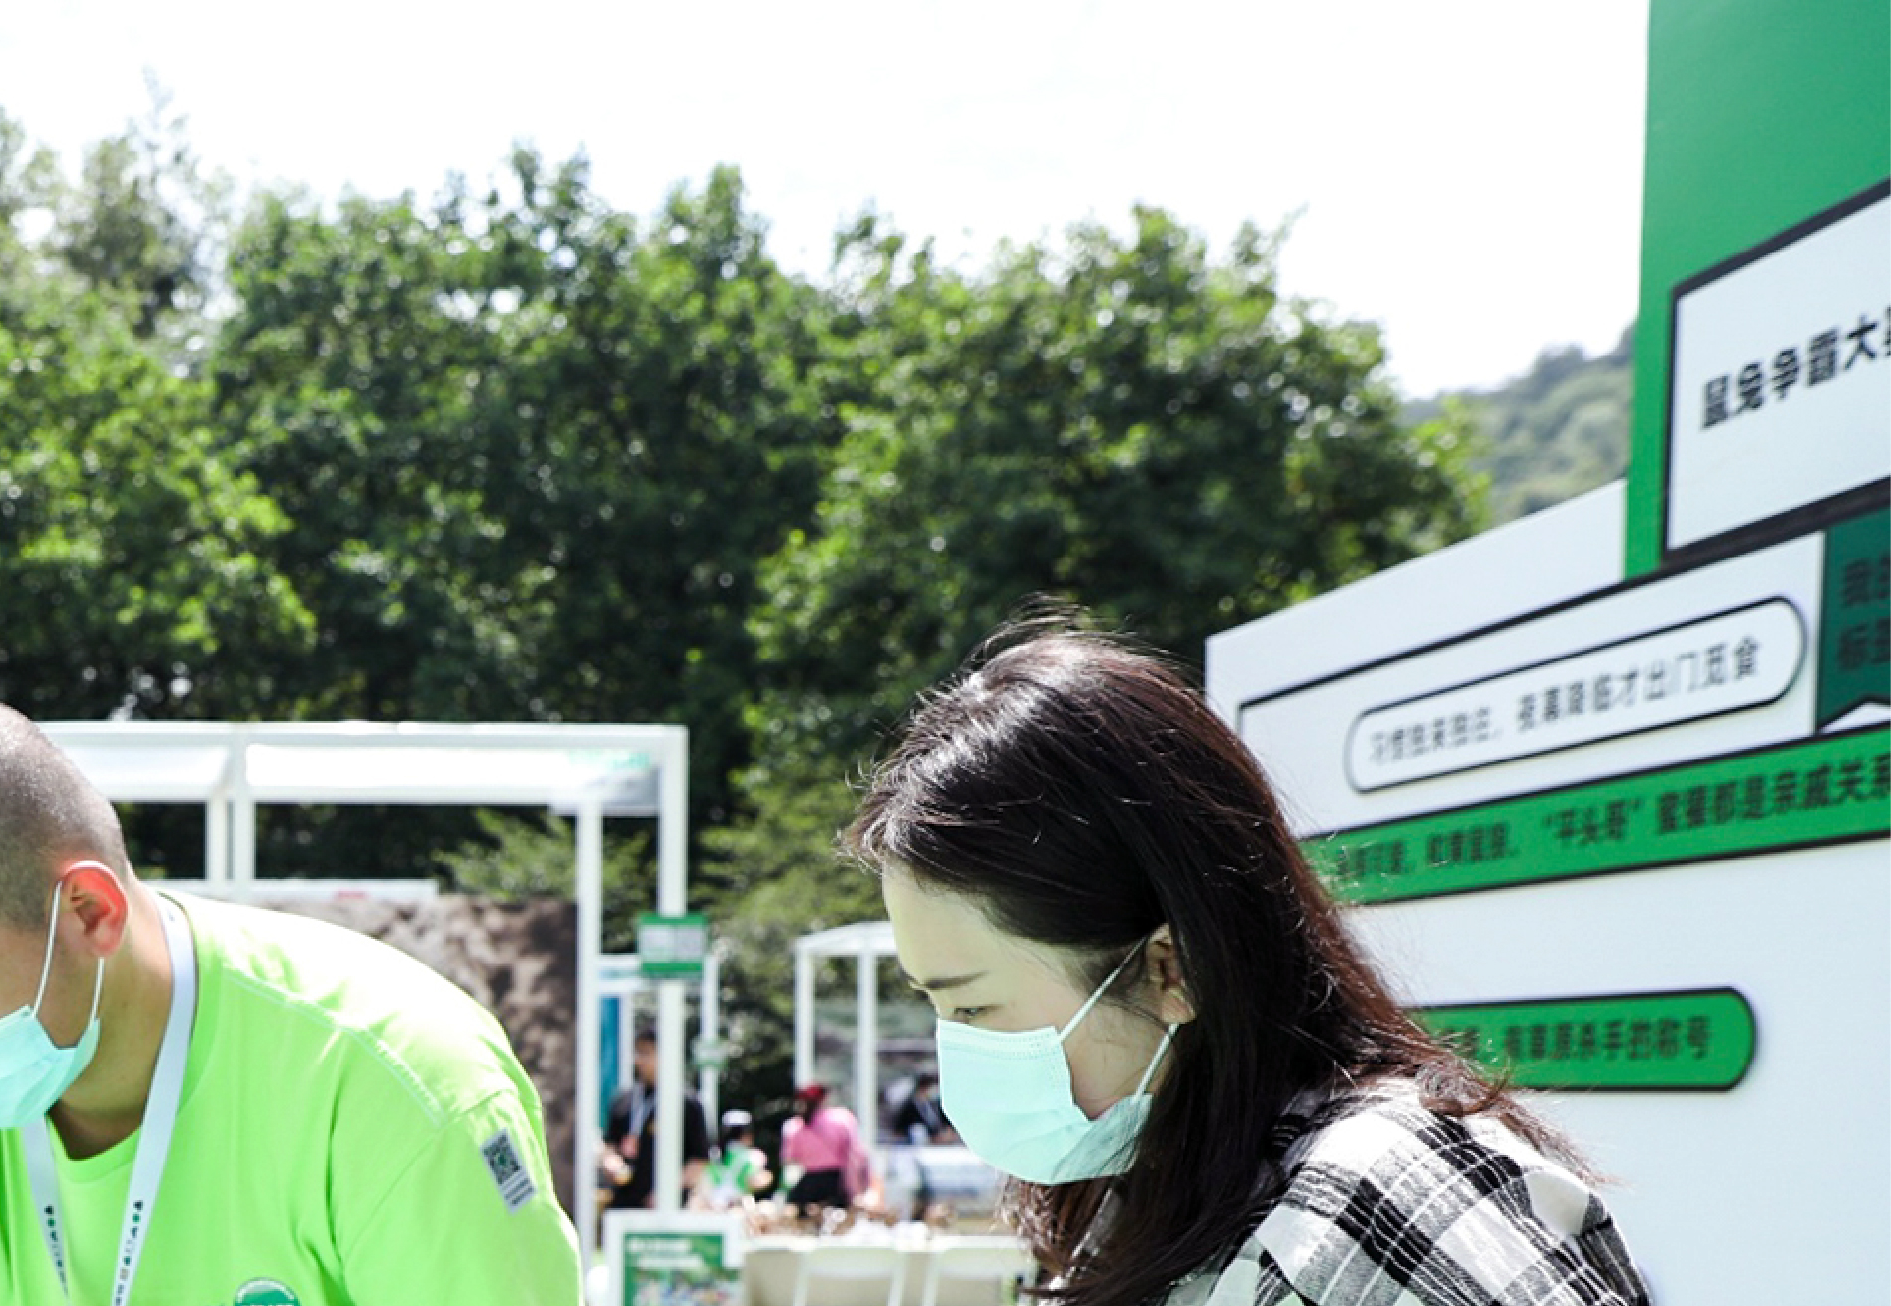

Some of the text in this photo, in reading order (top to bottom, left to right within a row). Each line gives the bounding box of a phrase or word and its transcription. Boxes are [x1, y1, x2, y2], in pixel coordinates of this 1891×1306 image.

[1702, 307, 1890, 430] 鼠兔争霸大
